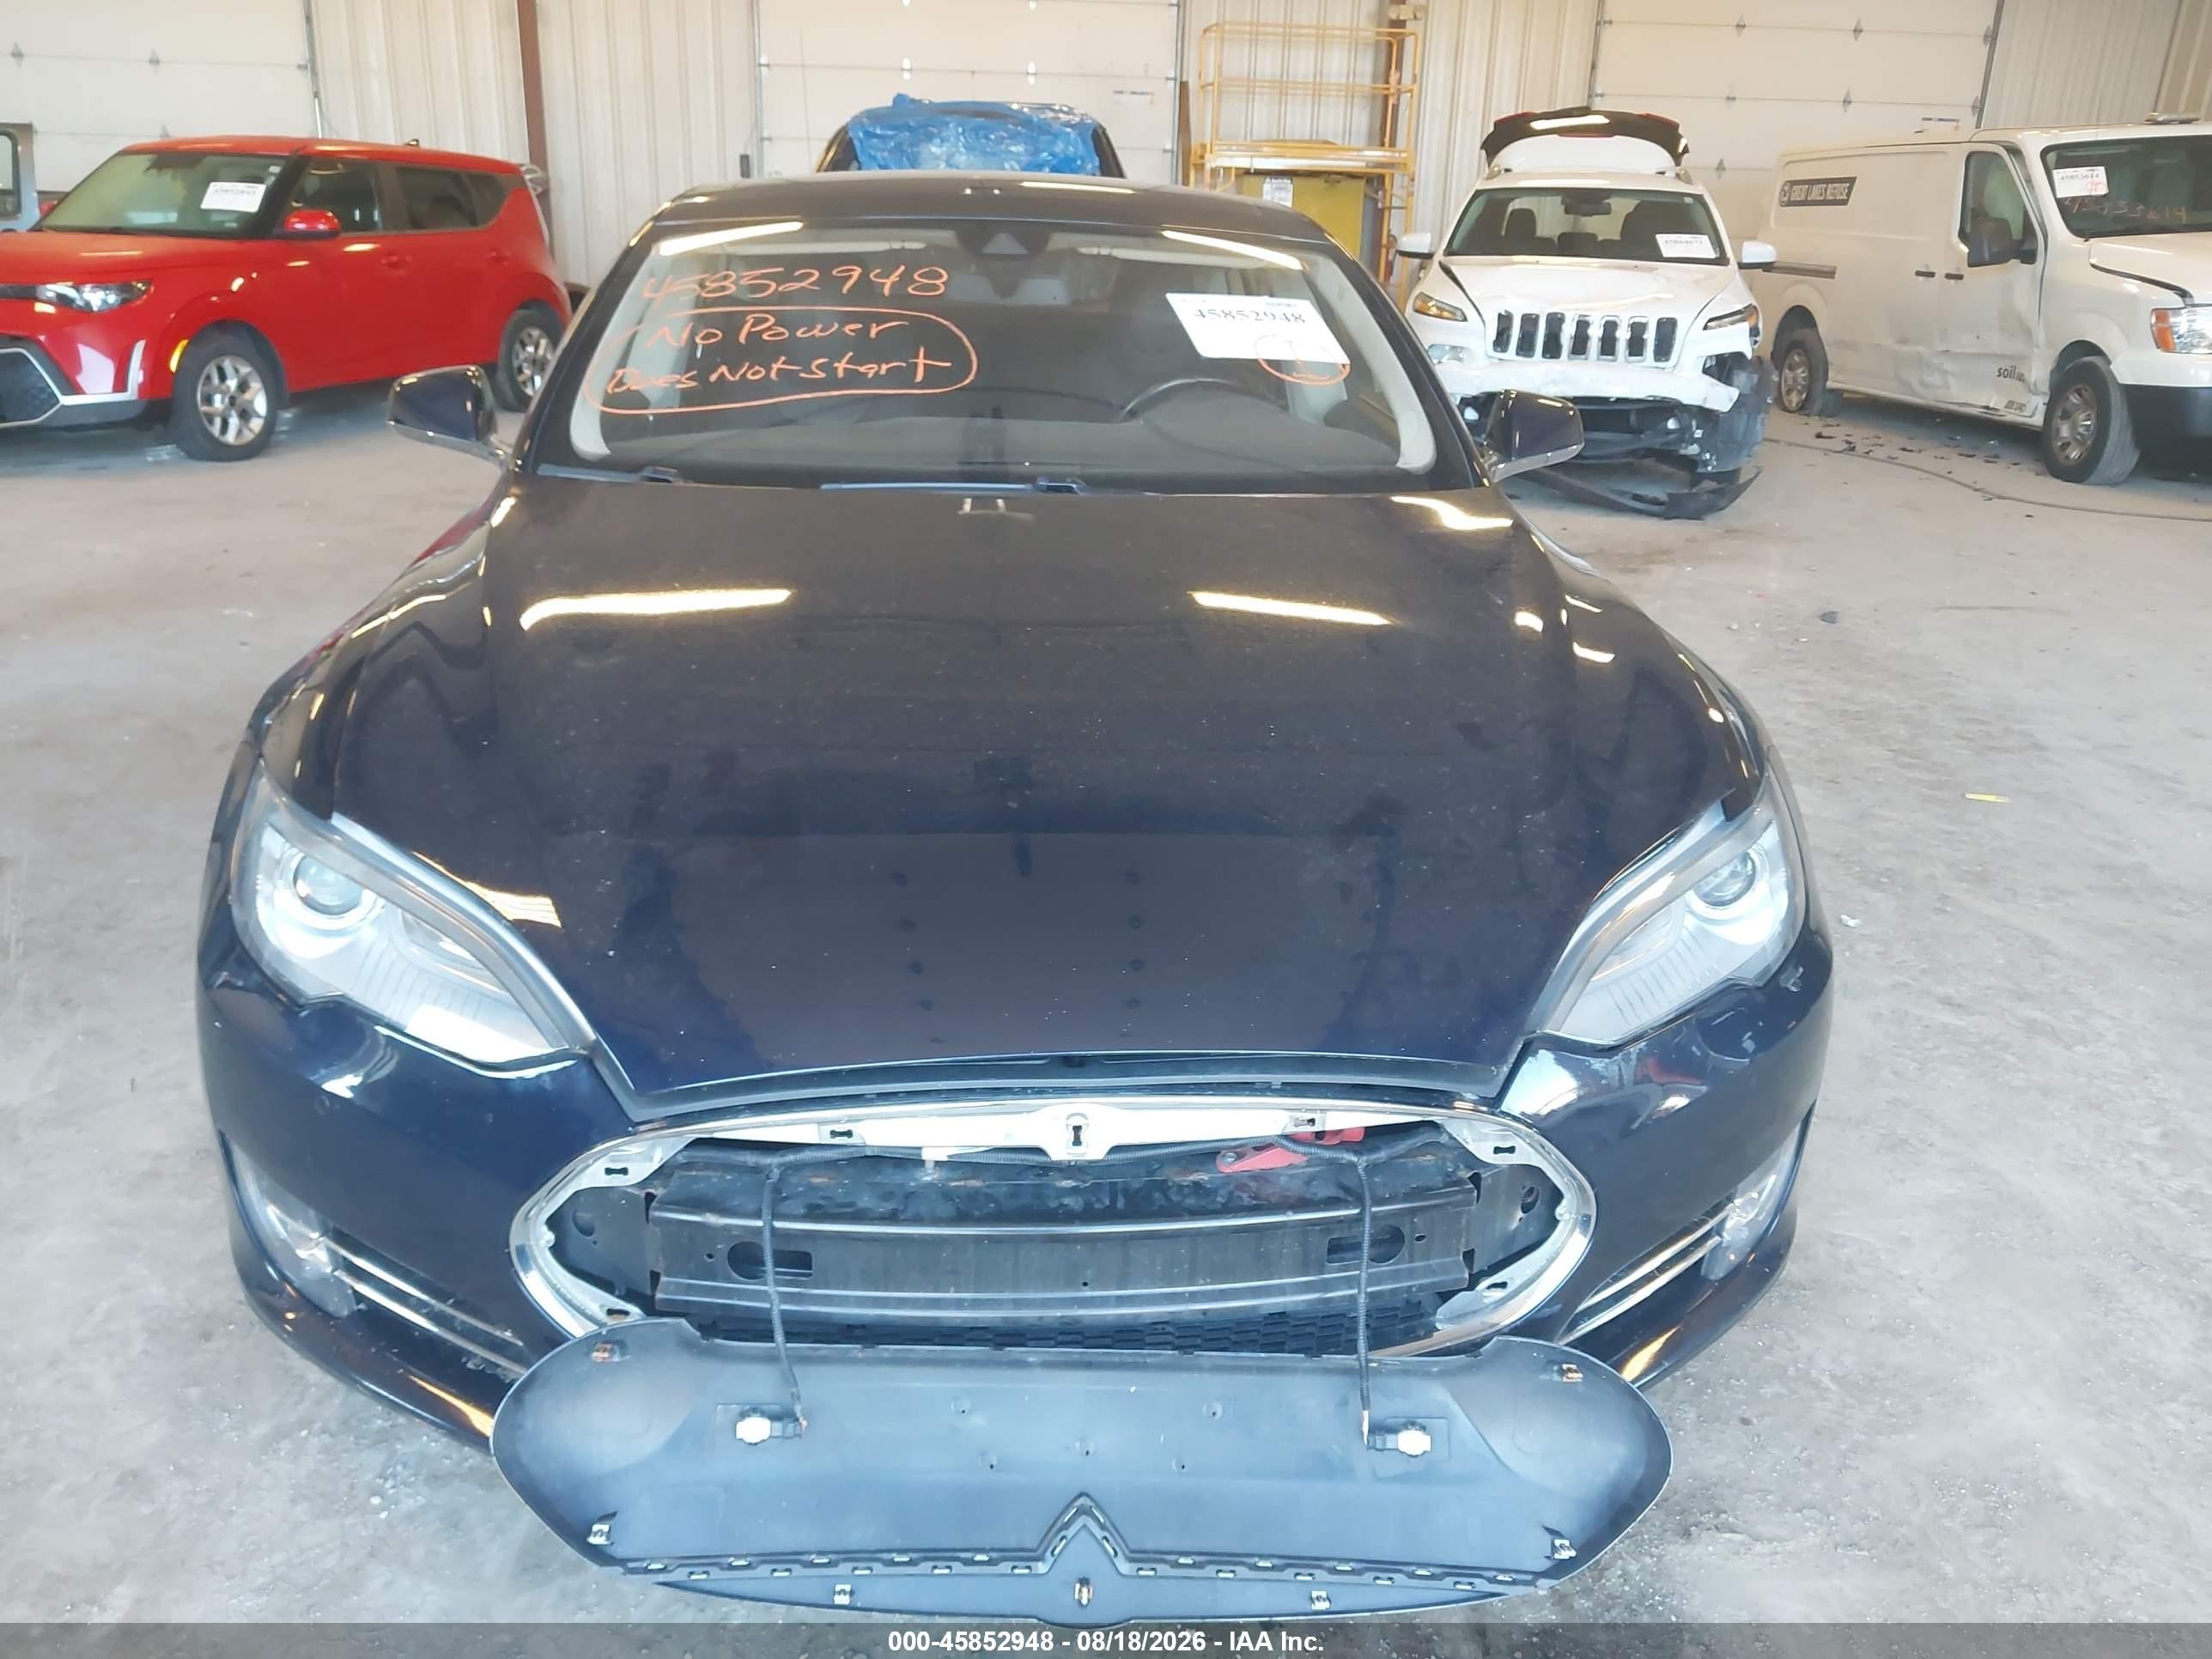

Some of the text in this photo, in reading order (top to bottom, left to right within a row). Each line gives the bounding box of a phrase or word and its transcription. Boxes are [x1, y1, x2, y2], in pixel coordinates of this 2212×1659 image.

[643, 264, 949, 301] 45852948
[646, 313, 909, 349] No Power
[1194, 308, 1307, 324] 45852948
[606, 368, 699, 395] Does
